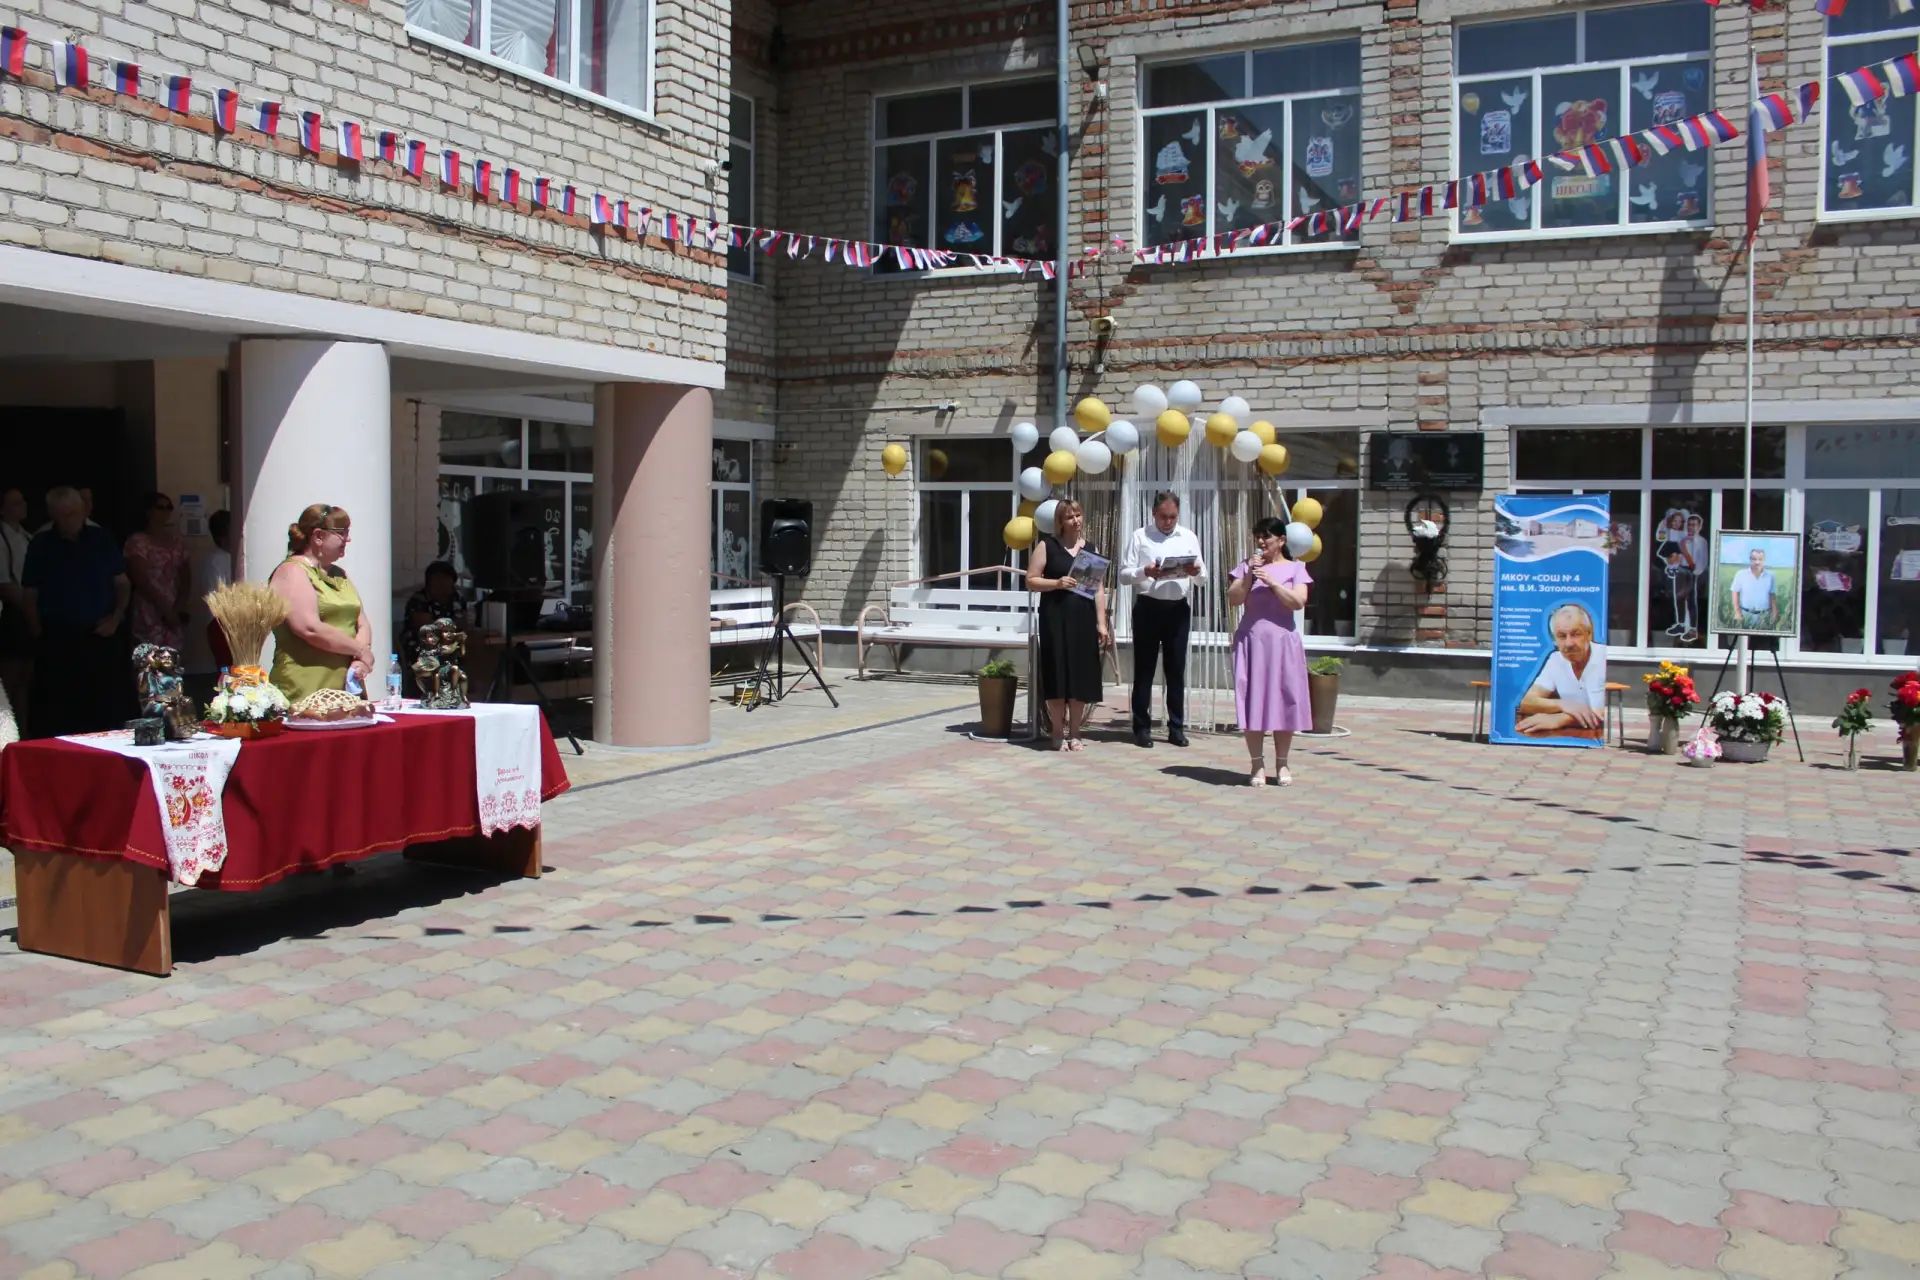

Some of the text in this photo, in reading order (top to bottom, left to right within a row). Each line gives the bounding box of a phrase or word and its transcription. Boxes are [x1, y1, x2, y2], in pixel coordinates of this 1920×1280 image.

[1501, 573, 1580, 582] МКОУ «СОШ № 4
[1519, 584, 1537, 592] В.И.
[1539, 584, 1600, 593] Затолокина»
